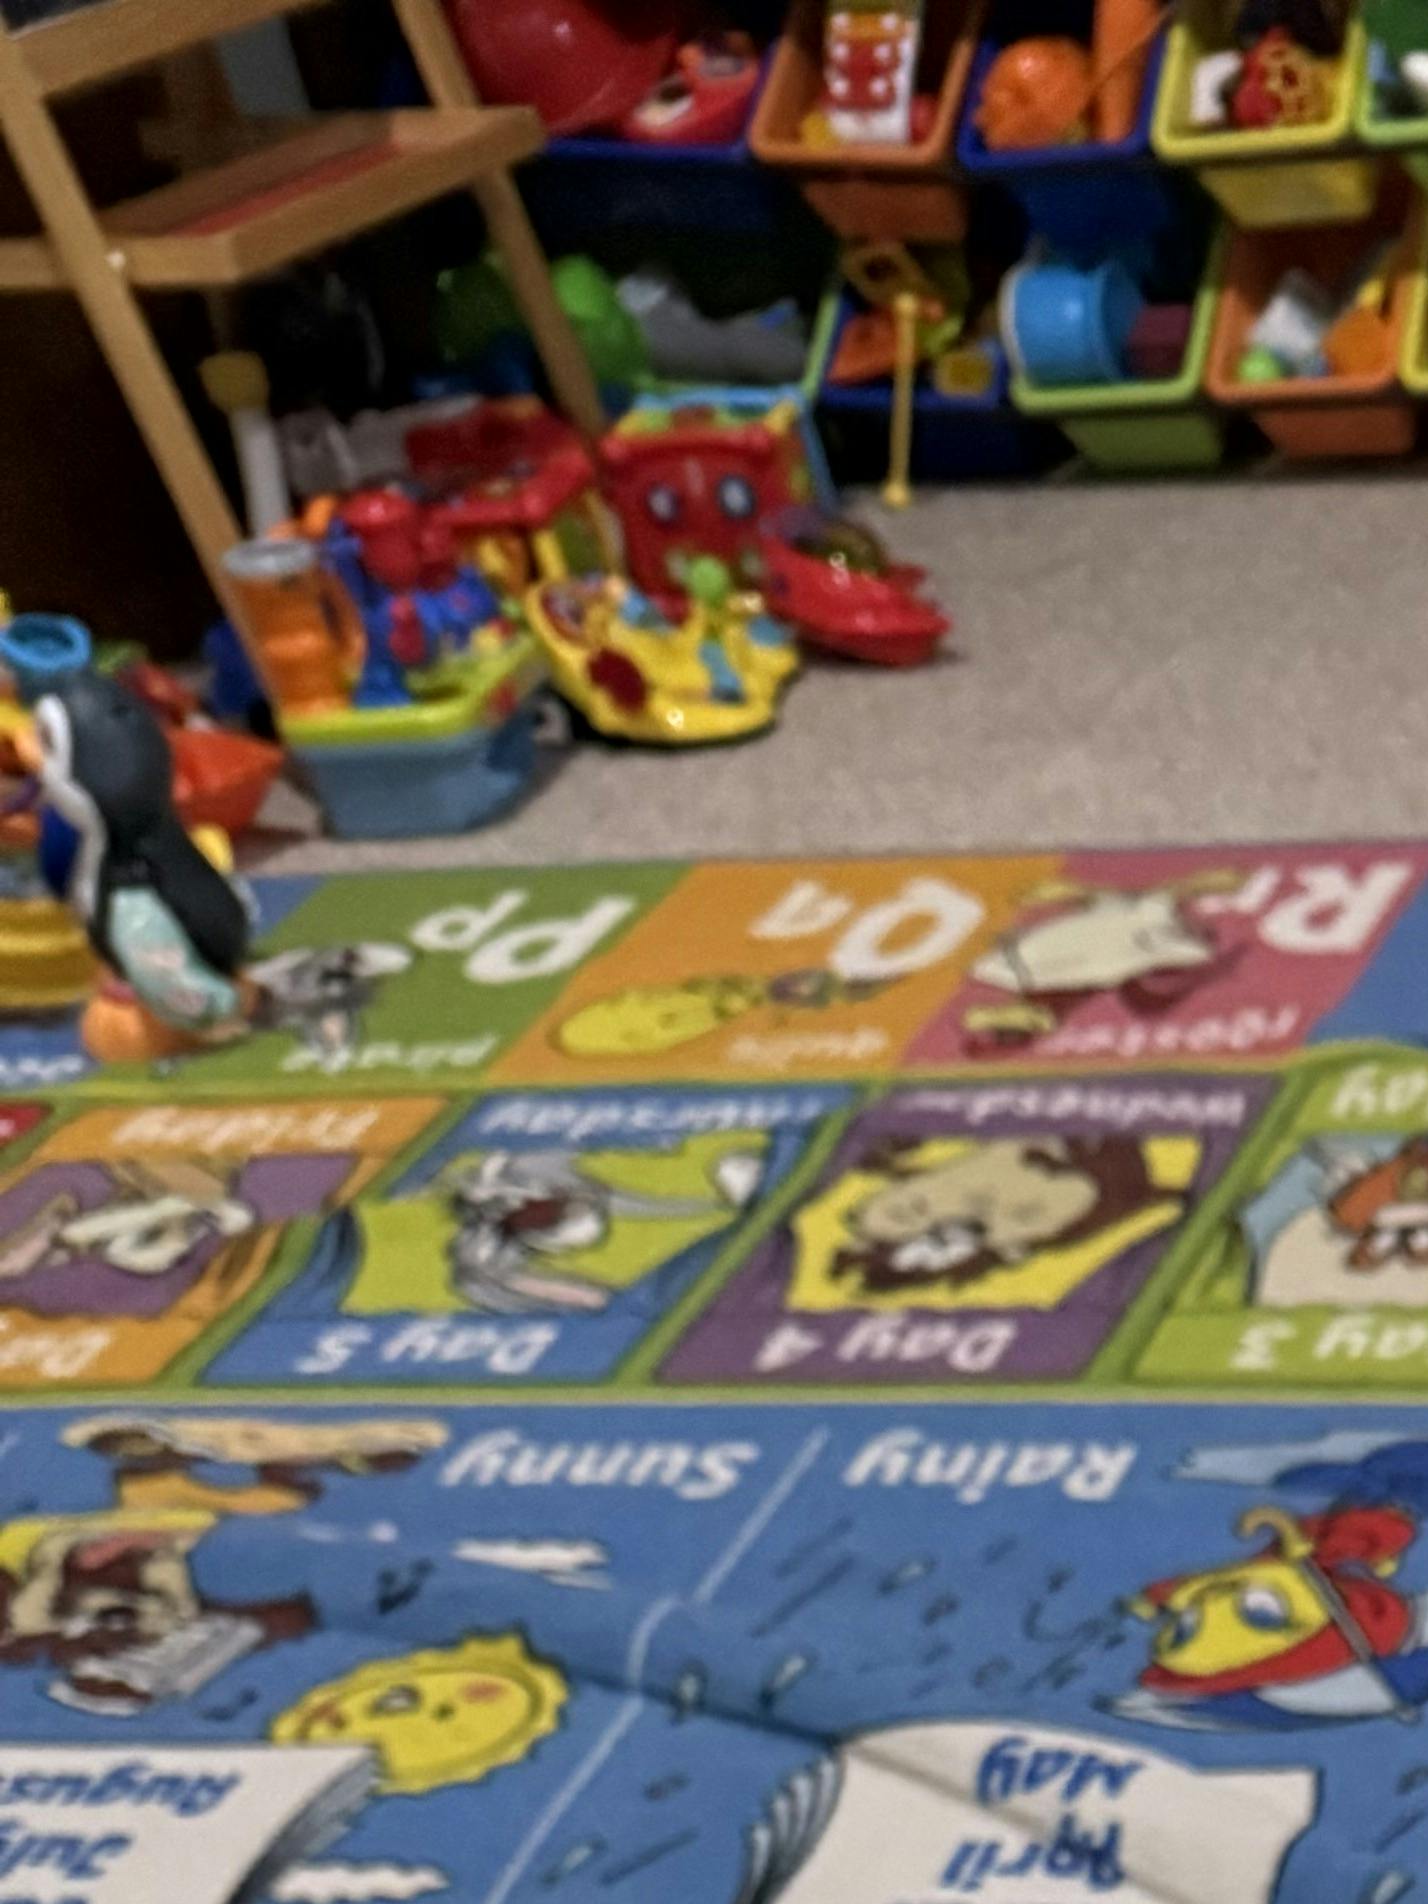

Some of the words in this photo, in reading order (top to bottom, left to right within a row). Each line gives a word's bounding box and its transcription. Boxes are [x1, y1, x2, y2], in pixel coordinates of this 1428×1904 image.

[409, 890, 638, 984] Pp
[747, 877, 985, 982] Qq
[1190, 858, 1416, 954] Rr
[895, 1090, 1246, 1128] Wednesd
[387, 1318, 560, 1374] Day
[754, 1327, 823, 1371] 4
[840, 1316, 1015, 1372] Day
[1230, 1326, 1281, 1370] 3
[438, 1429, 760, 1498] Sunny
[845, 1429, 1140, 1503] Rainy
[0, 1760, 242, 1818] Augus
[975, 1736, 1147, 1802] May
[945, 1815, 1126, 1891] April
